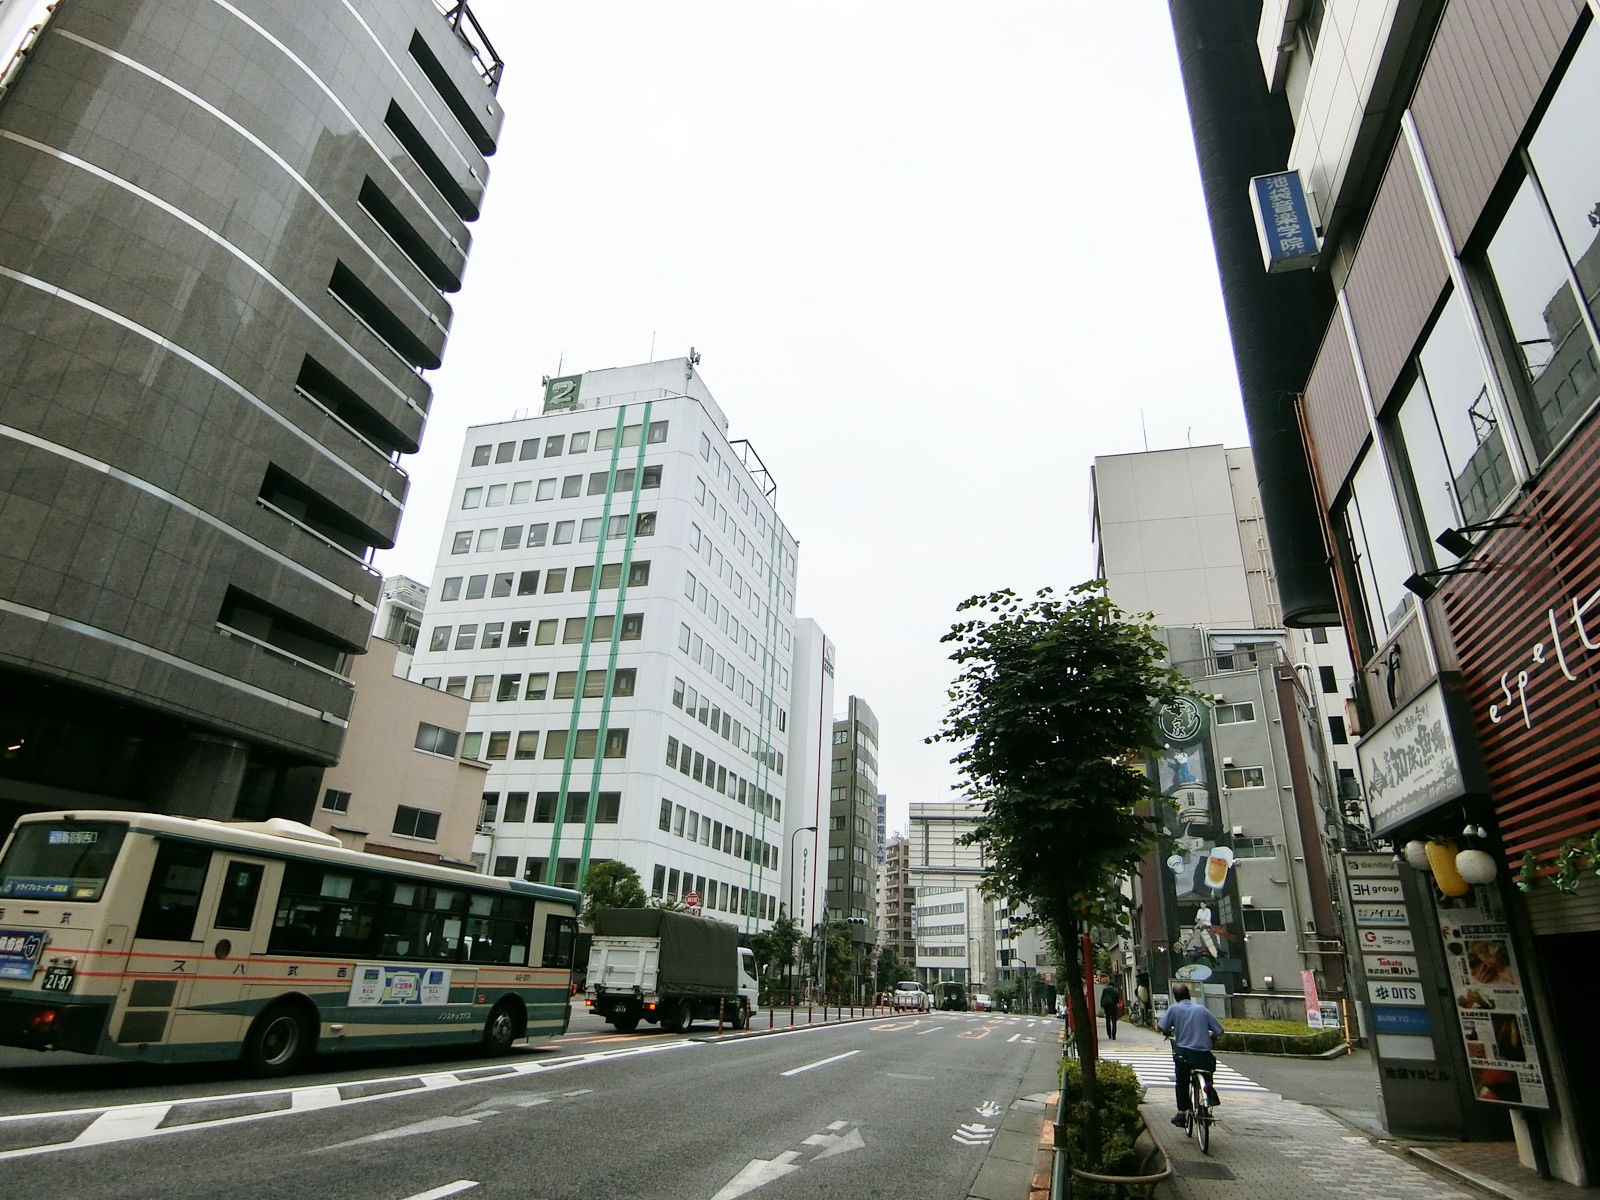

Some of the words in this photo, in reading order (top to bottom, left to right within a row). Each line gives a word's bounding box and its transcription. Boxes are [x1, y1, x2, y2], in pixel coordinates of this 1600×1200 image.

[1266, 175, 1305, 252] 池袋音楽学院
[876, 806, 885, 864] 東京福祉大学
[1377, 957, 1403, 966] Tohato
[1391, 987, 1417, 999] DITS
[438, 1012, 472, 1020] ノンステップバス
